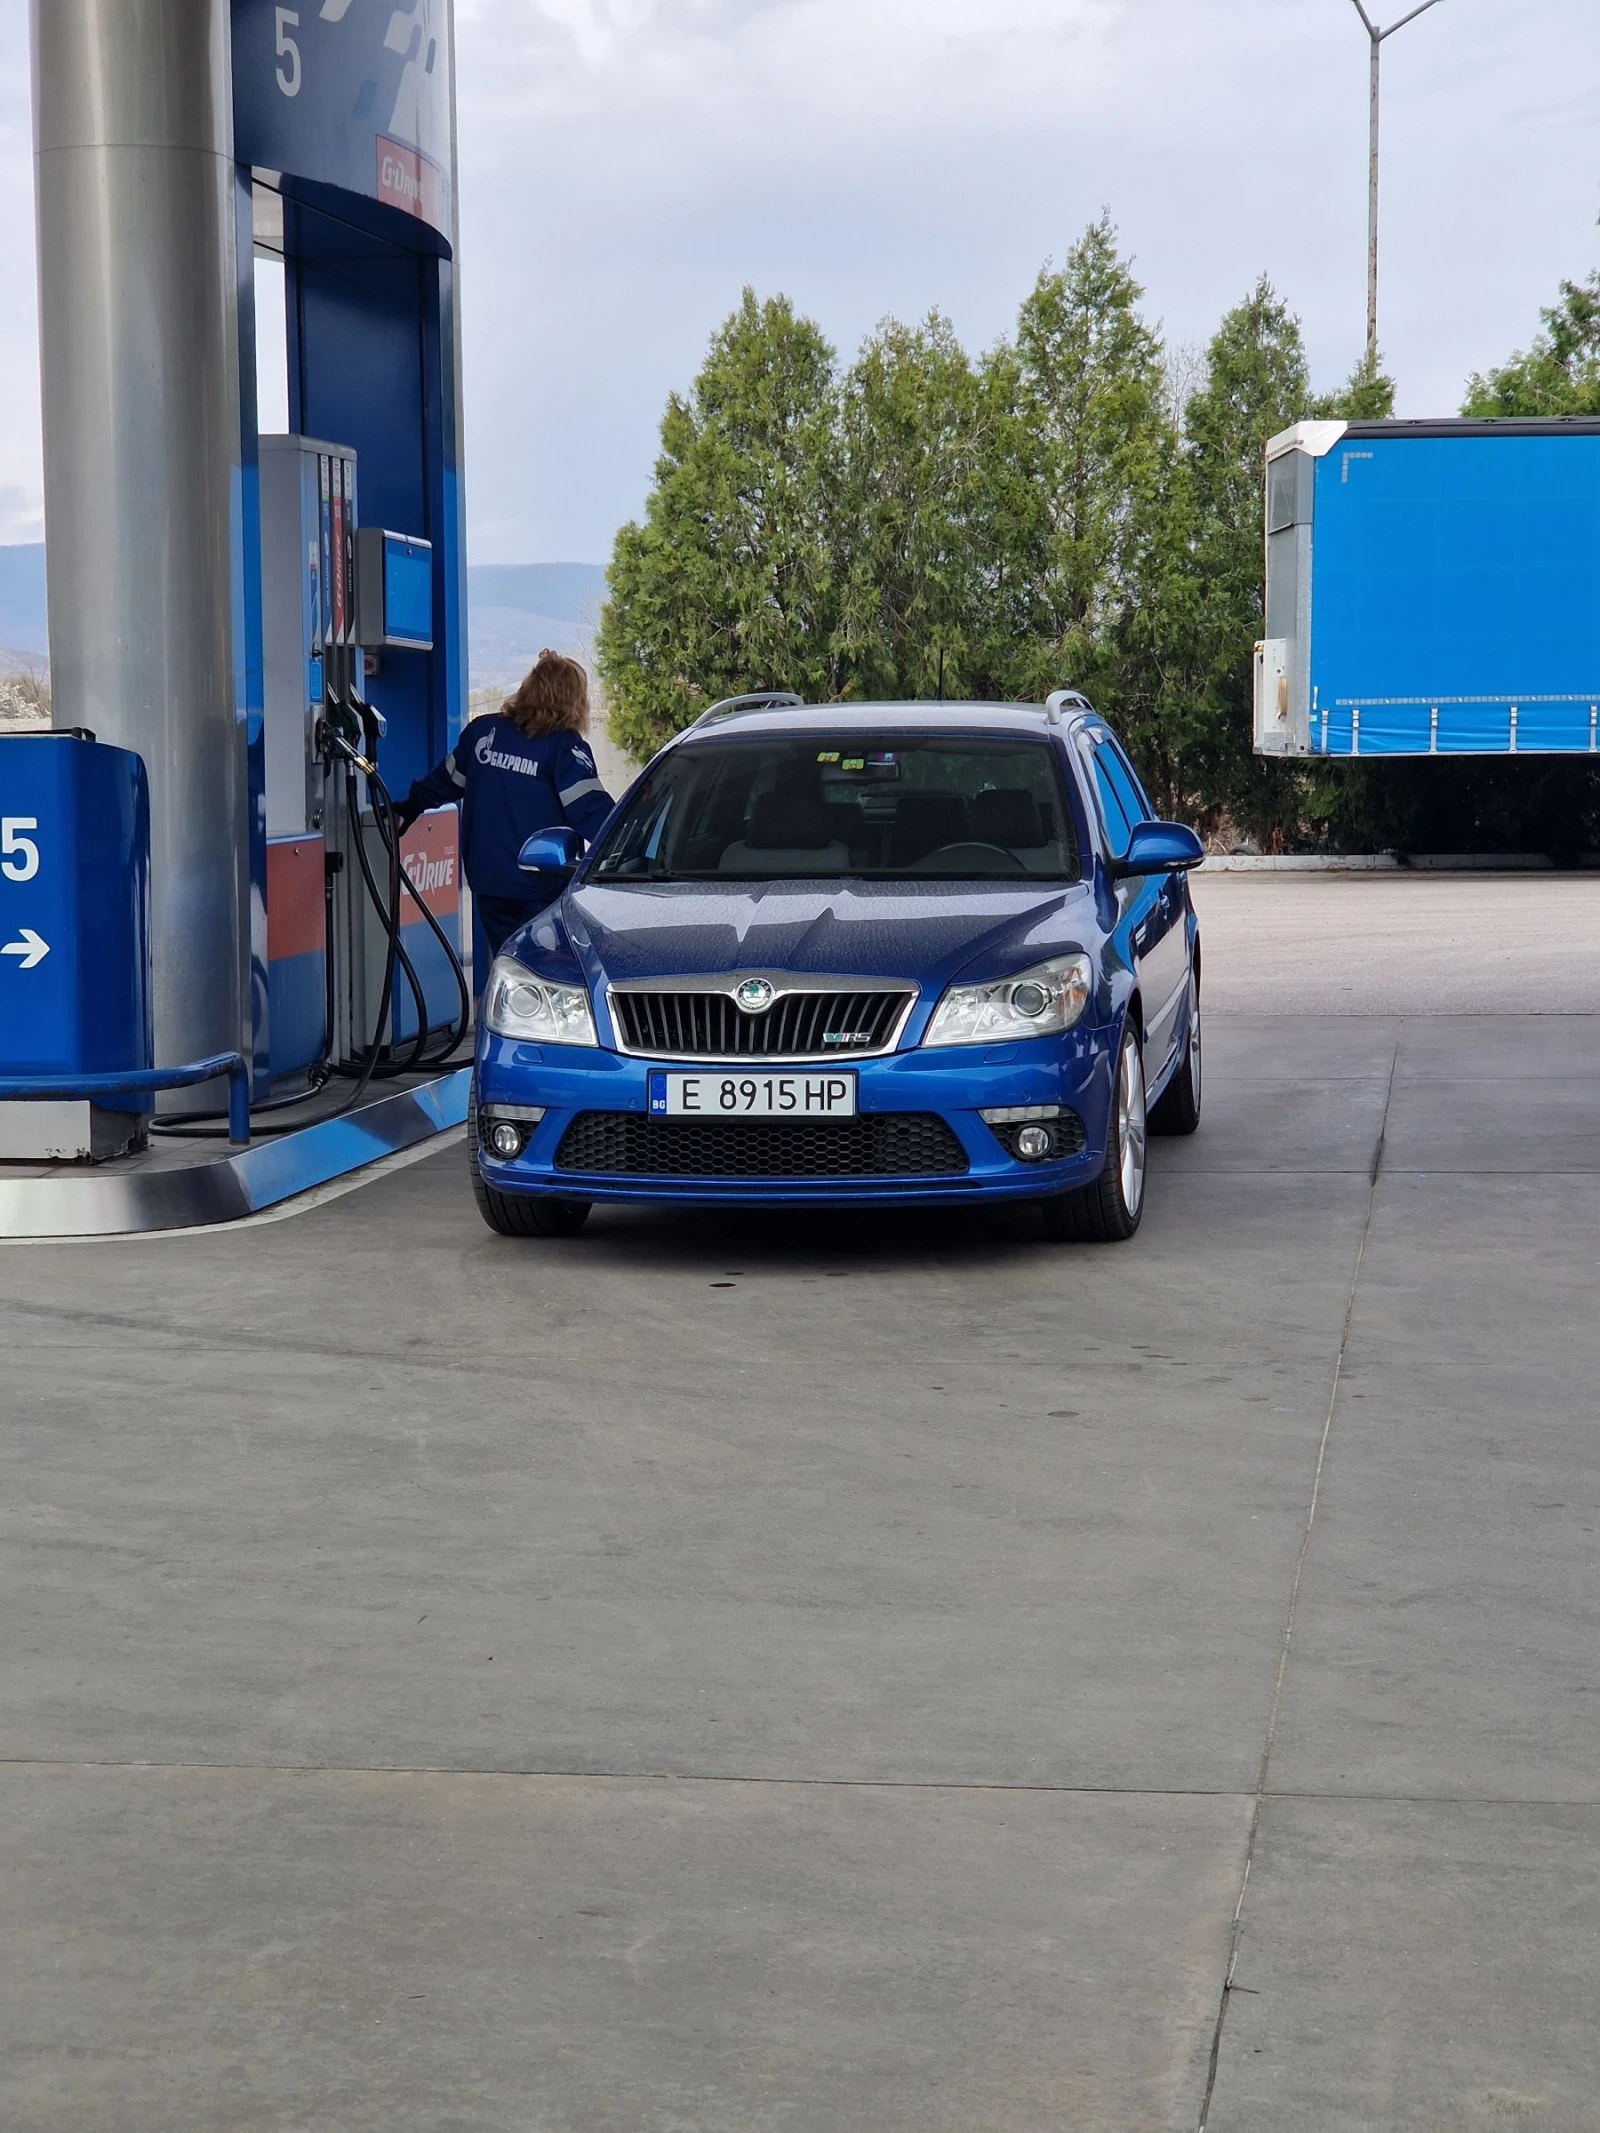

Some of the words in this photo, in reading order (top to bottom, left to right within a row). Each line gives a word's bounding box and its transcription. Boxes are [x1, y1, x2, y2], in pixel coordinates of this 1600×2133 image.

[275, 6, 302, 97] 5
[490, 751, 538, 777] GAZPROM
[1, 817, 39, 882] 5
[652, 1100, 666, 1110] BG
[682, 1079, 701, 1110] E
[719, 1079, 797, 1111] 8915
[805, 1080, 847, 1111] HP
